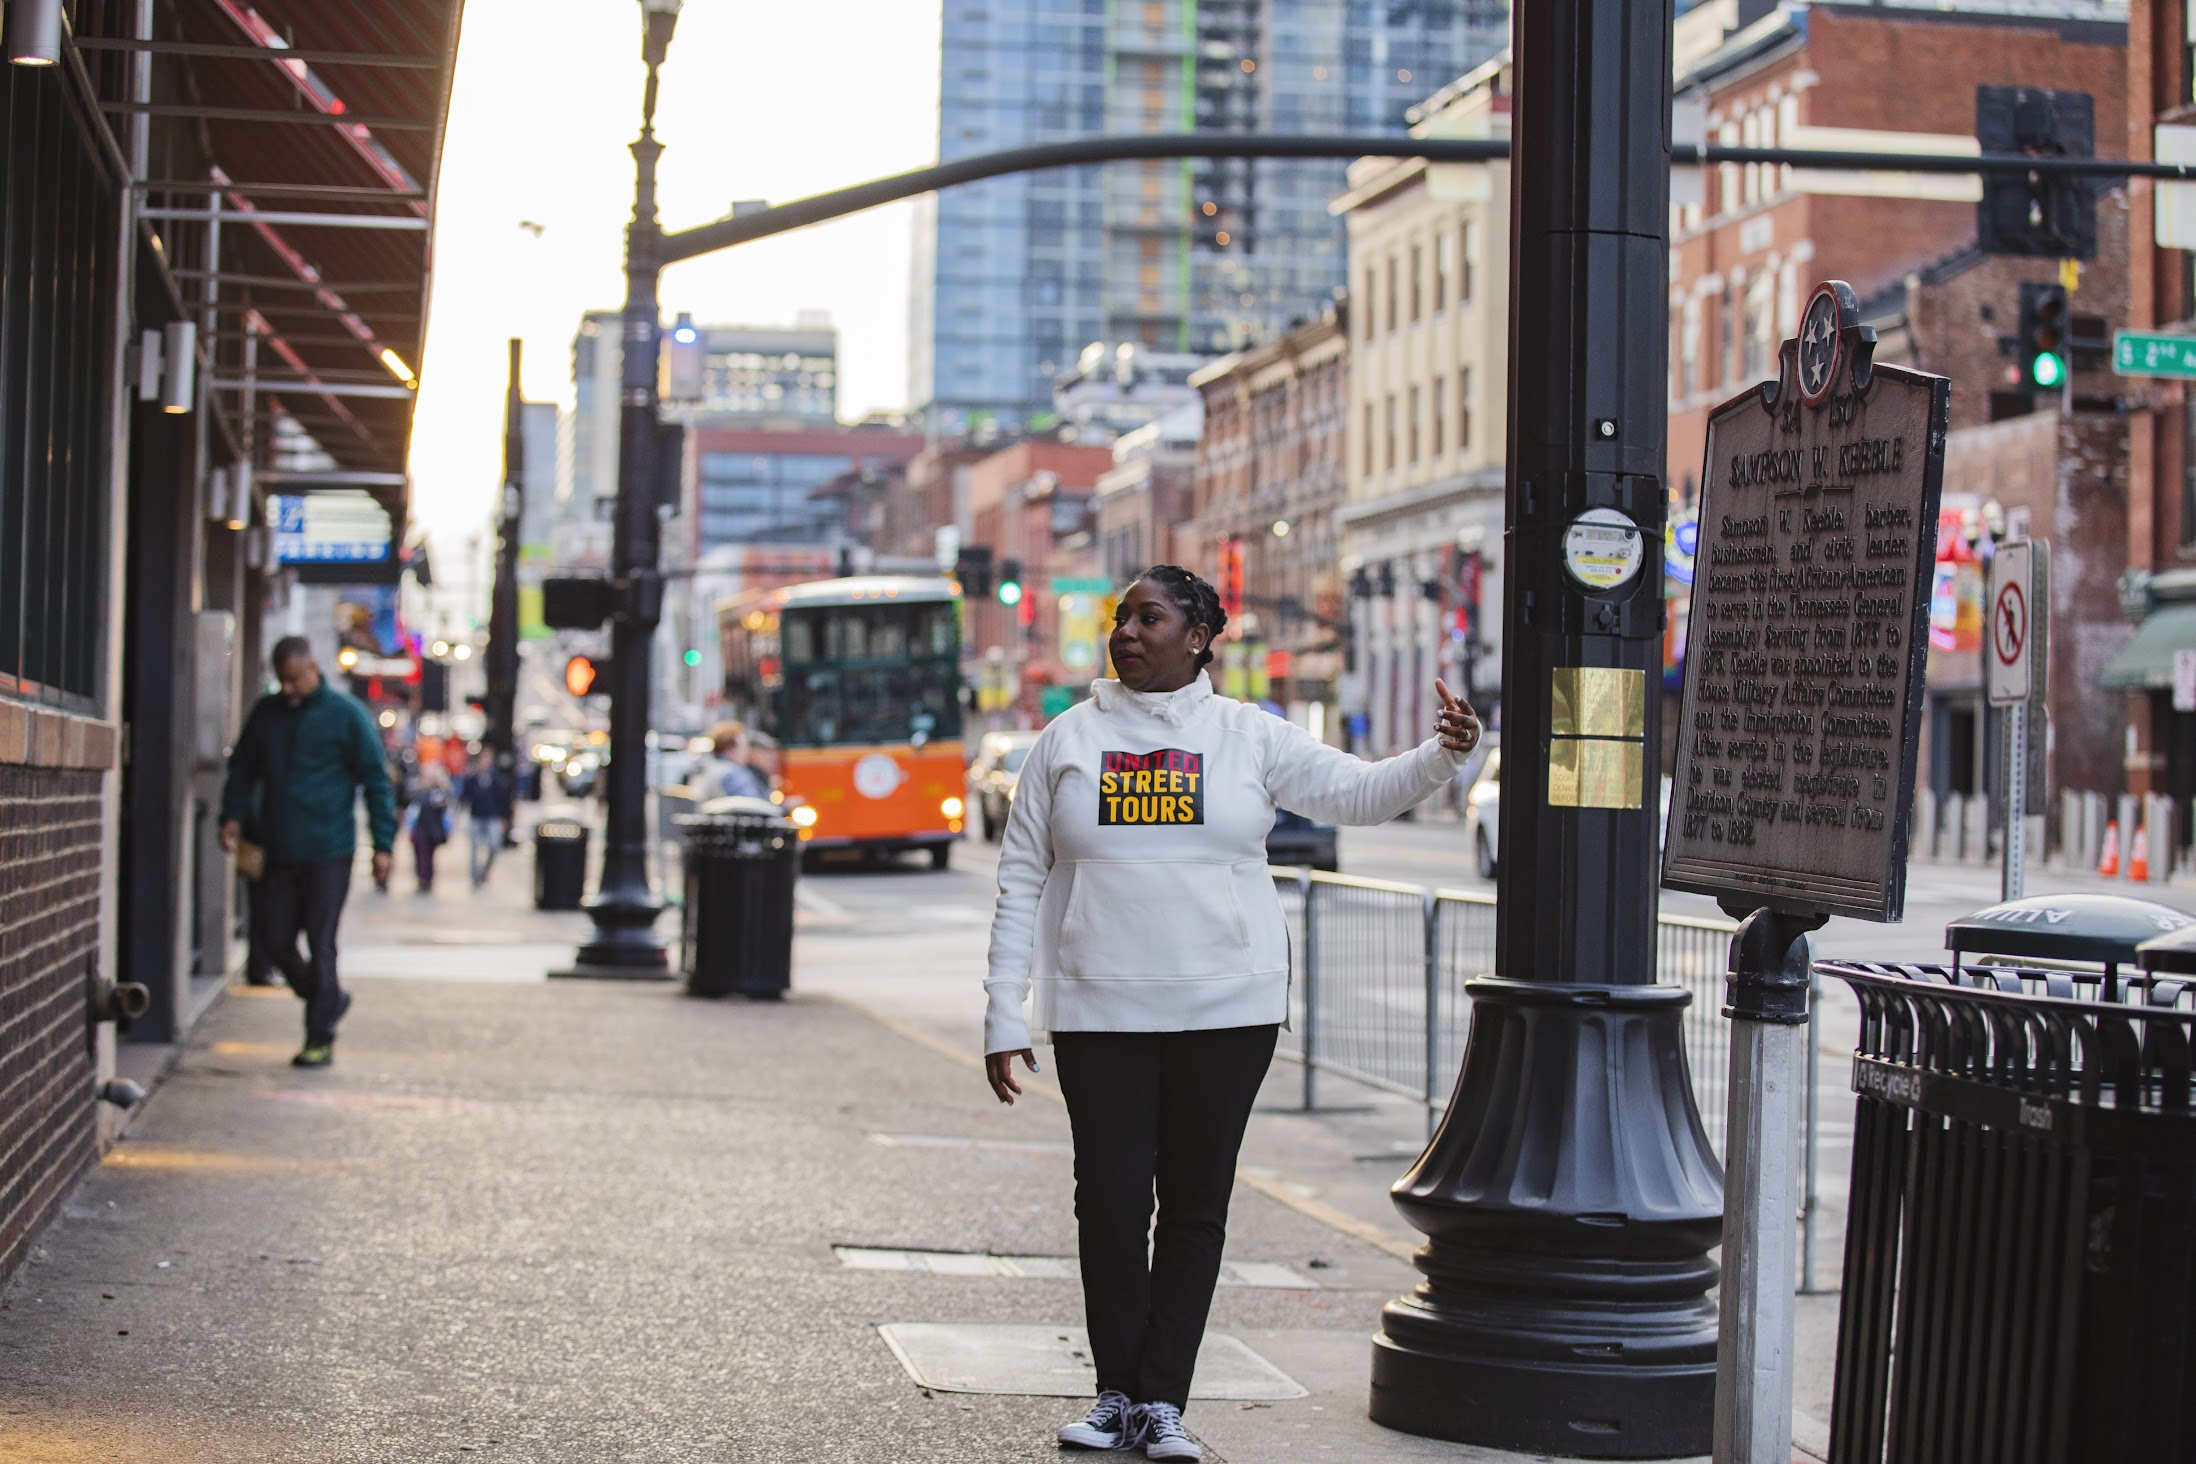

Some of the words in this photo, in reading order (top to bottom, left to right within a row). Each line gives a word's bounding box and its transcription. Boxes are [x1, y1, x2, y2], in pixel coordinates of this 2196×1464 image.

[1780, 399, 1802, 432] 3A
[1828, 393, 1857, 428] 150
[1729, 449, 1804, 487] SAMPSON
[1813, 445, 1829, 478] W.
[1839, 437, 1905, 478] KEEBLE
[1721, 515, 1768, 542] Sampson
[1779, 508, 1792, 534] W.
[1864, 501, 1912, 529] barber,
[1711, 542, 1778, 566] businessman,
[1790, 537, 1814, 562] and
[1824, 536, 1854, 561] civic
[1866, 531, 1909, 558] leader,
[1708, 568, 1748, 593] became
[1750, 566, 1767, 591] the
[1769, 565, 1795, 592] first
[1707, 597, 1718, 618] to
[1721, 601, 1750, 619] serve
[1752, 596, 1764, 619] in
[1767, 593, 1786, 618] the
[1790, 592, 1850, 617] Tennessee
[1854, 590, 1905, 616] General
[1765, 624, 1809, 651] Serving
[1814, 623, 1845, 647] from
[1851, 621, 1880, 647] 1873
[1886, 622, 1901, 647] to
[1730, 650, 1768, 675] Keeble
[1771, 657, 1791, 675] was
[1794, 652, 1854, 677] appointed
[1859, 652, 1873, 677] to
[1877, 652, 1899, 678] the
[1699, 677, 1729, 700] House
[1732, 678, 1778, 708] Military
[1782, 678, 1825, 705] Affairs
[1828, 679, 1895, 707] Committee
[1695, 705, 1715, 729] and
[1721, 706, 1738, 730] the
[1744, 705, 1815, 735] Immigration
[1106, 750, 1199, 773] UNITED
[1693, 731, 1723, 757] After
[1728, 736, 1768, 759] service
[1774, 737, 1785, 761] in
[1793, 737, 1813, 764] the
[1101, 769, 1200, 794] STREET
[1689, 758, 1703, 783] he
[1713, 765, 1732, 785] was
[1742, 762, 1784, 790] elected
[1793, 772, 1860, 799] magistrate
[1873, 772, 1886, 799] in
[1106, 795, 1194, 823] TOURS
[1686, 786, 1734, 815] Davidson
[1737, 790, 1779, 823] County
[1781, 797, 1804, 822] and
[1805, 799, 1847, 826] served
[1851, 800, 1884, 830] from
[1683, 813, 1708, 840] 1877
[1711, 818, 1724, 842] to
[1868, 1064, 1910, 1099] Recycle
[2019, 1096, 2053, 1130] Trash
